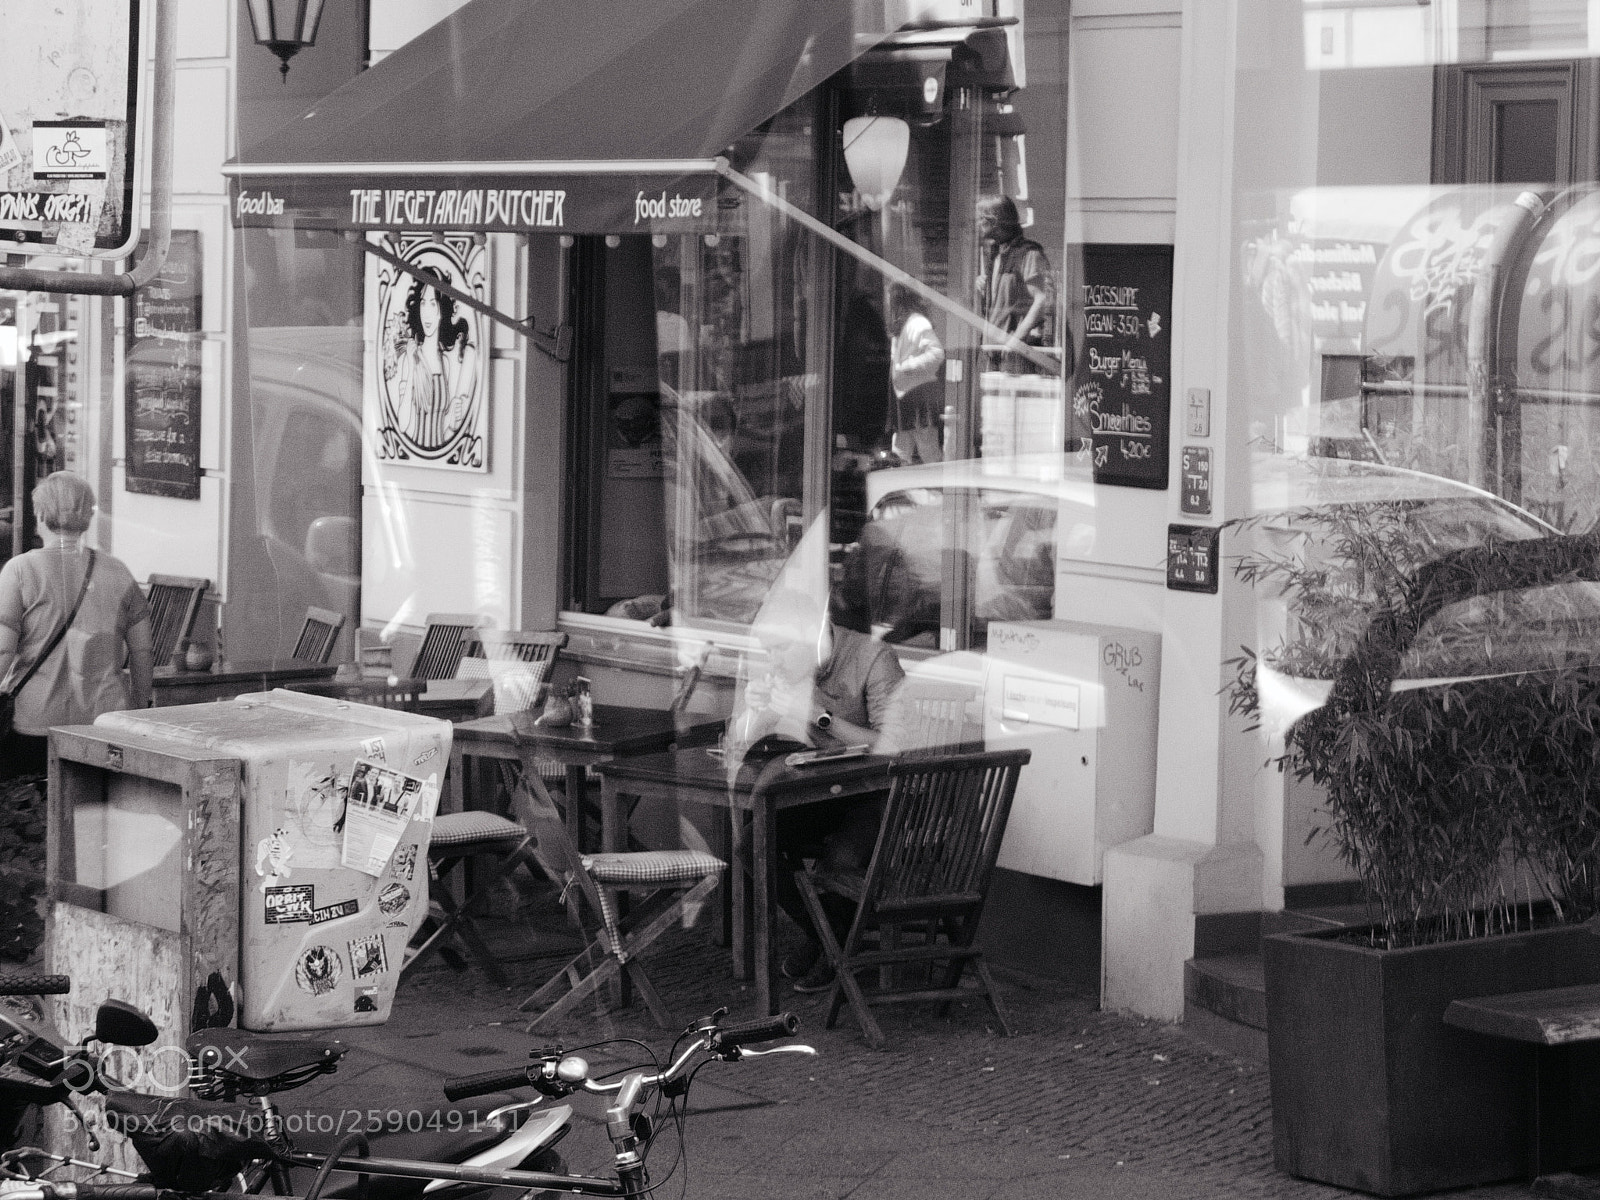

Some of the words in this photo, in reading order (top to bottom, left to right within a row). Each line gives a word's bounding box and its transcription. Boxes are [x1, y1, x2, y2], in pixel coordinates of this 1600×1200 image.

[237, 190, 266, 218] food
[350, 189, 382, 225] THE
[384, 188, 485, 226] VEGETARIAN
[485, 189, 566, 227] BUTCHER
[635, 191, 667, 225] food
[668, 192, 702, 219] store
[1082, 285, 1139, 307] TAGESSUPPE
[1089, 348, 1121, 378] Burger
[1089, 401, 1152, 432] Smoothies
[1103, 642, 1143, 667] GRUB
